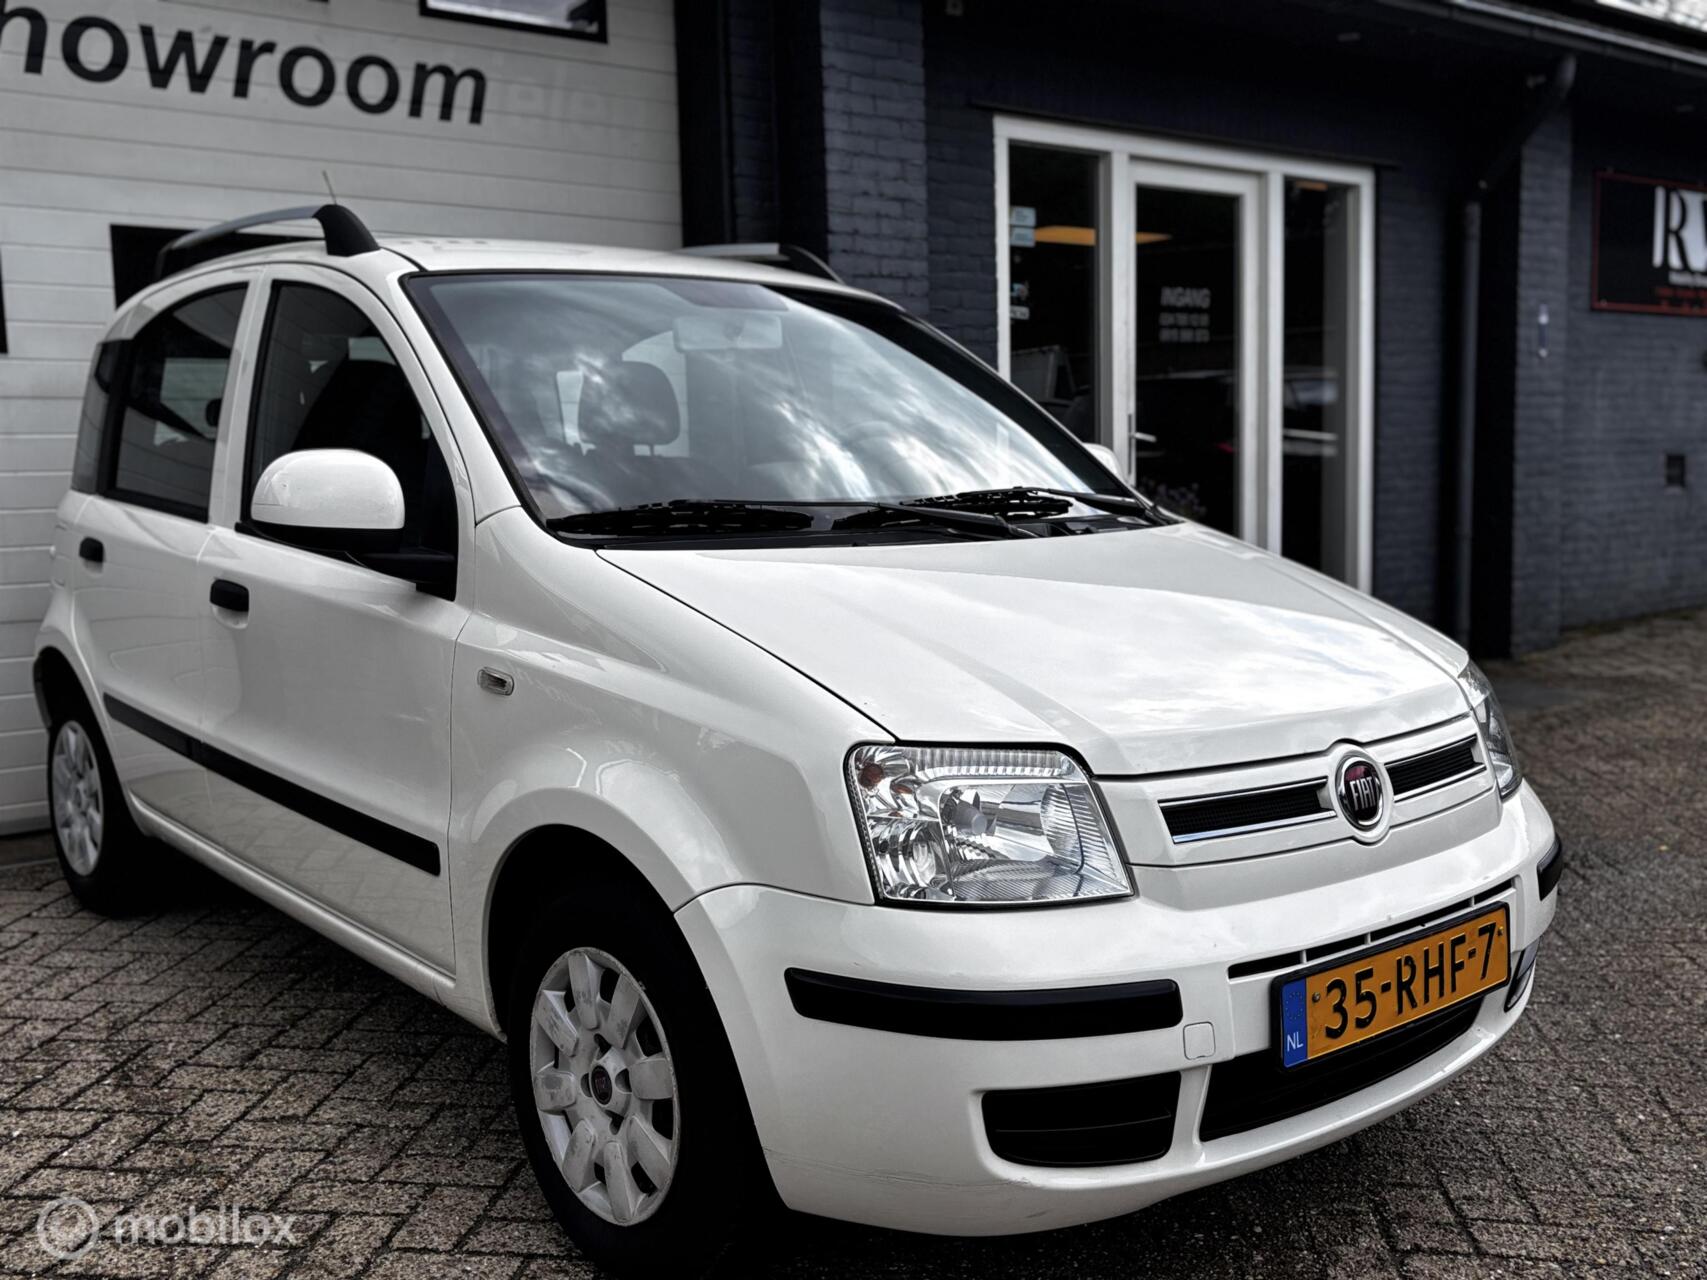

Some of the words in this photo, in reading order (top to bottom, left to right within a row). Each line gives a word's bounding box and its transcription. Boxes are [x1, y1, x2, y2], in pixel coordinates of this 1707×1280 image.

[1160, 286, 1211, 309] INGANG
[1349, 776, 1376, 811] FIAT
[1324, 921, 1498, 1040] 35-RHF-7
[1286, 1031, 1304, 1052] NL
